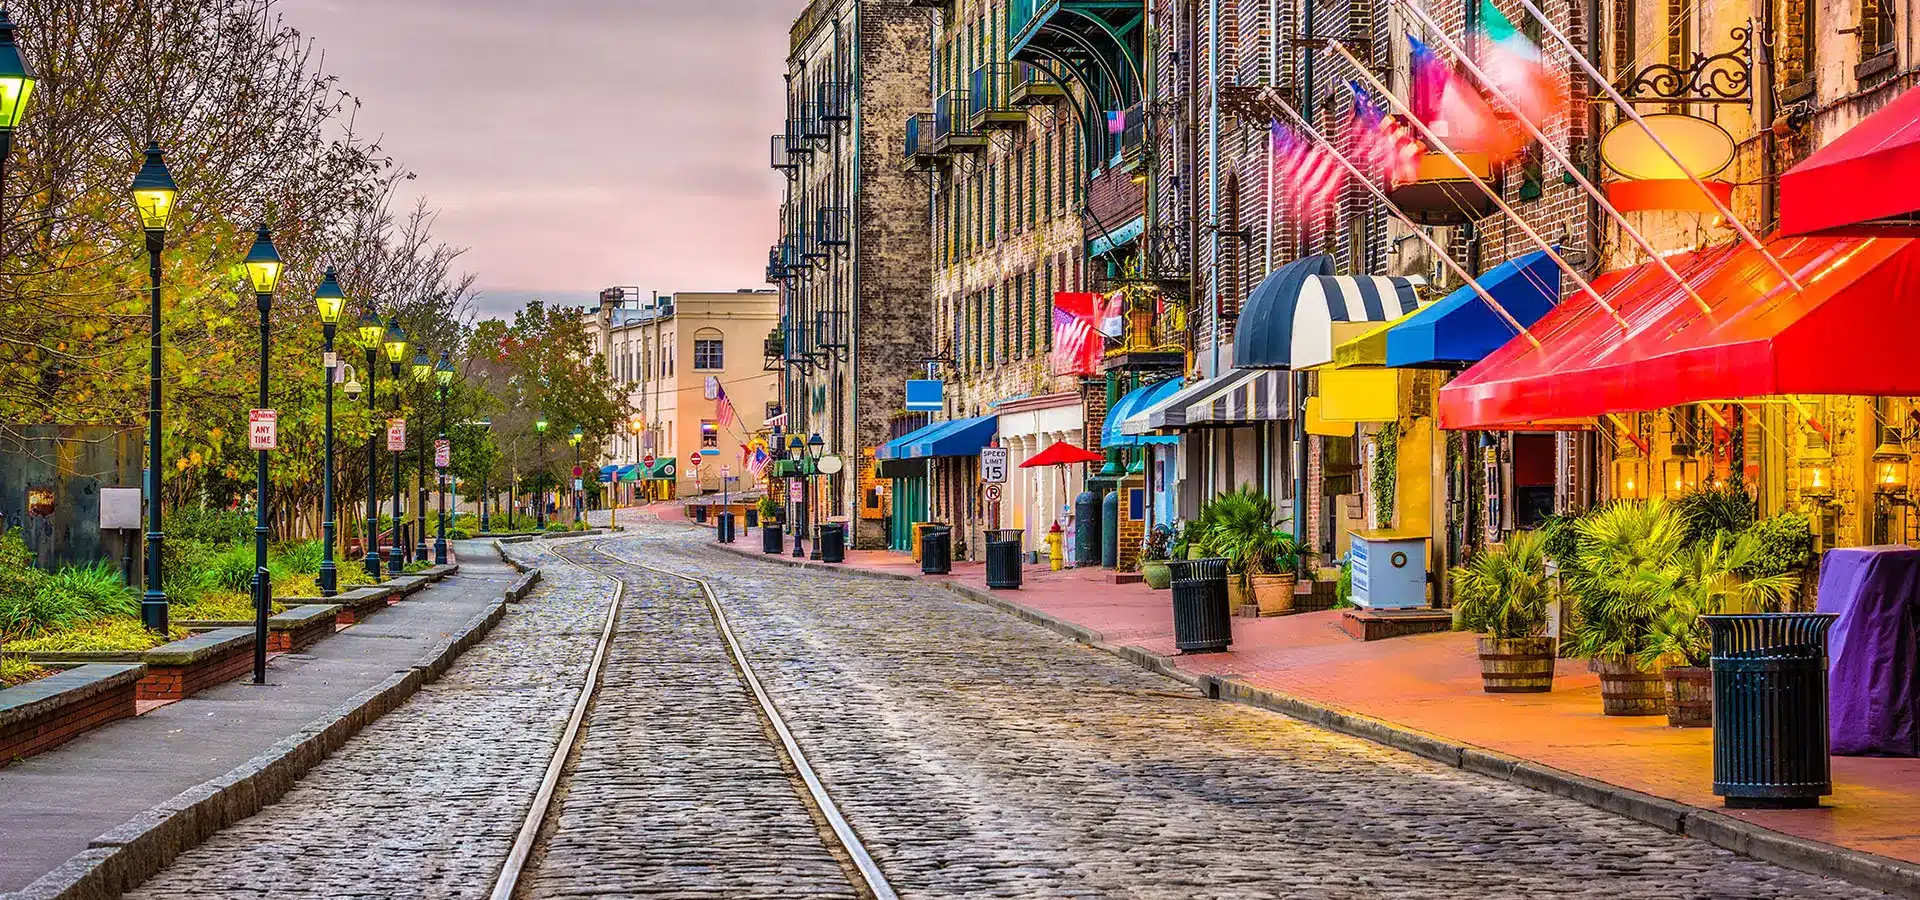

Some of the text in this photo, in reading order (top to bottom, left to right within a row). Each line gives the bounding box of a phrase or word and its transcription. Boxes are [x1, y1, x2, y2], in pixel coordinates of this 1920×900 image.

[255, 425, 270, 434] ANY
[254, 435, 271, 444] TIME
[985, 466, 1003, 480] 15
